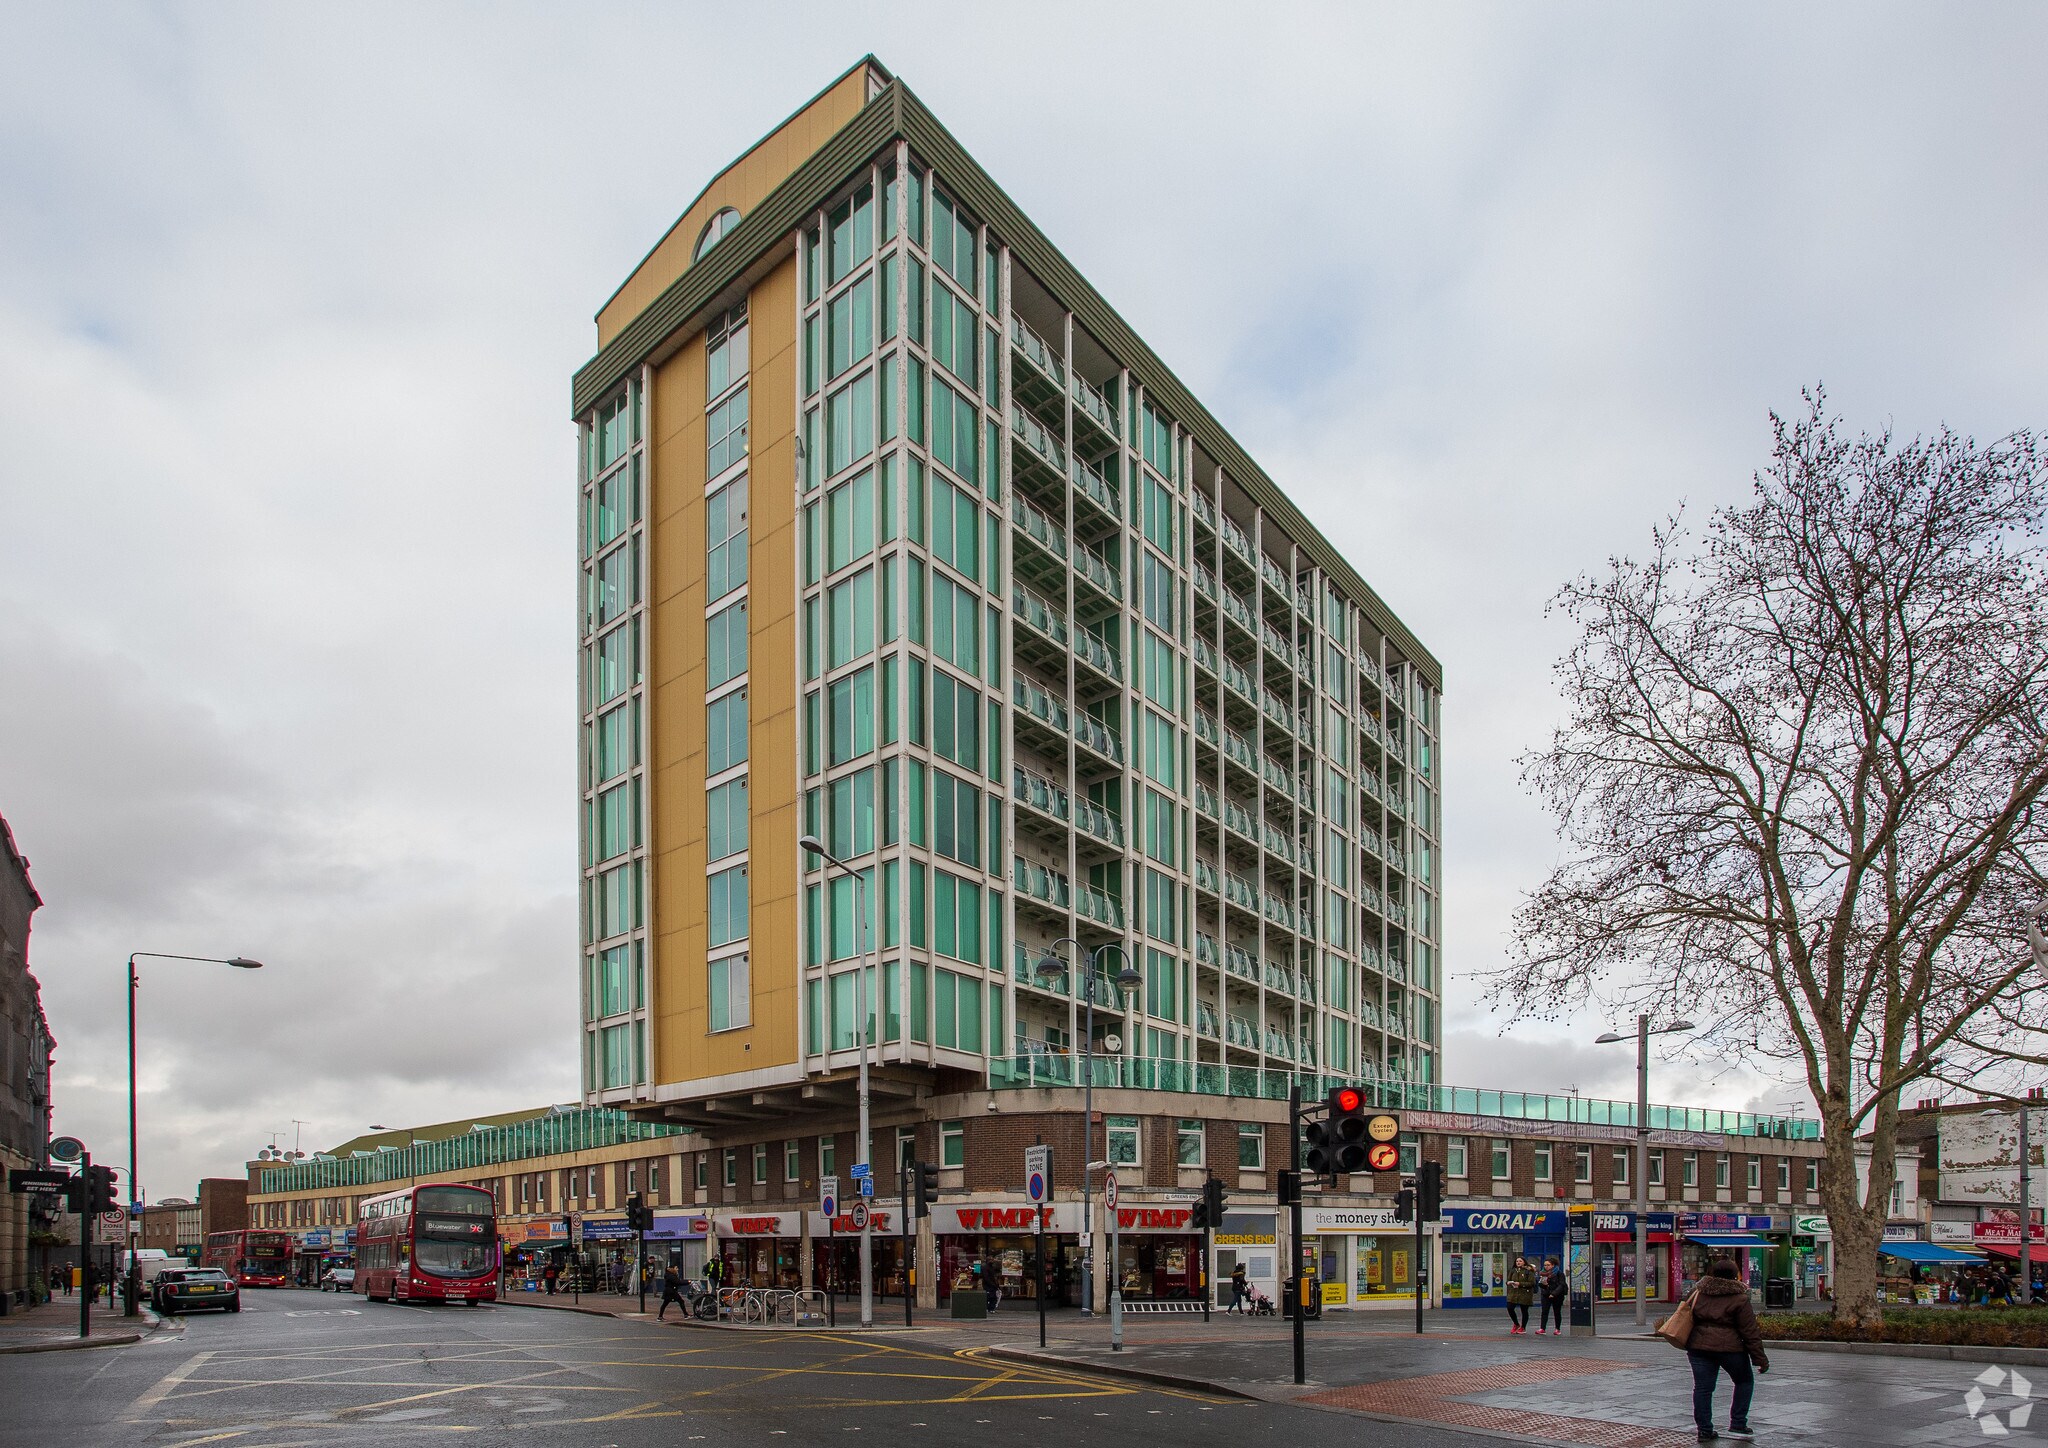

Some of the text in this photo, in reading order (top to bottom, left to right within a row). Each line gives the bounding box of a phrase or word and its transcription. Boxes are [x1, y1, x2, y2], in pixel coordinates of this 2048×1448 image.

[1406, 1111, 1430, 1126] TOWER
[1431, 1113, 1454, 1128] PHASE
[1454, 1115, 1471, 1129] SOLD
[1027, 1148, 1046, 1156] Restricted
[1029, 1163, 1043, 1172] ZONE
[956, 1207, 1054, 1228] WIMPY
[1117, 1208, 1194, 1228] WIMP
[1315, 1213, 1332, 1224] the
[1334, 1213, 1378, 1226] money
[1467, 1213, 1535, 1230] CORAL
[428, 1222, 484, 1233] Bluewater 96
[731, 1216, 778, 1233] WIMPY
[1660, 1222, 1672, 1230] king
[1984, 1228, 2005, 1237] MEAT
[1214, 1234, 1276, 1245] GREENS END
